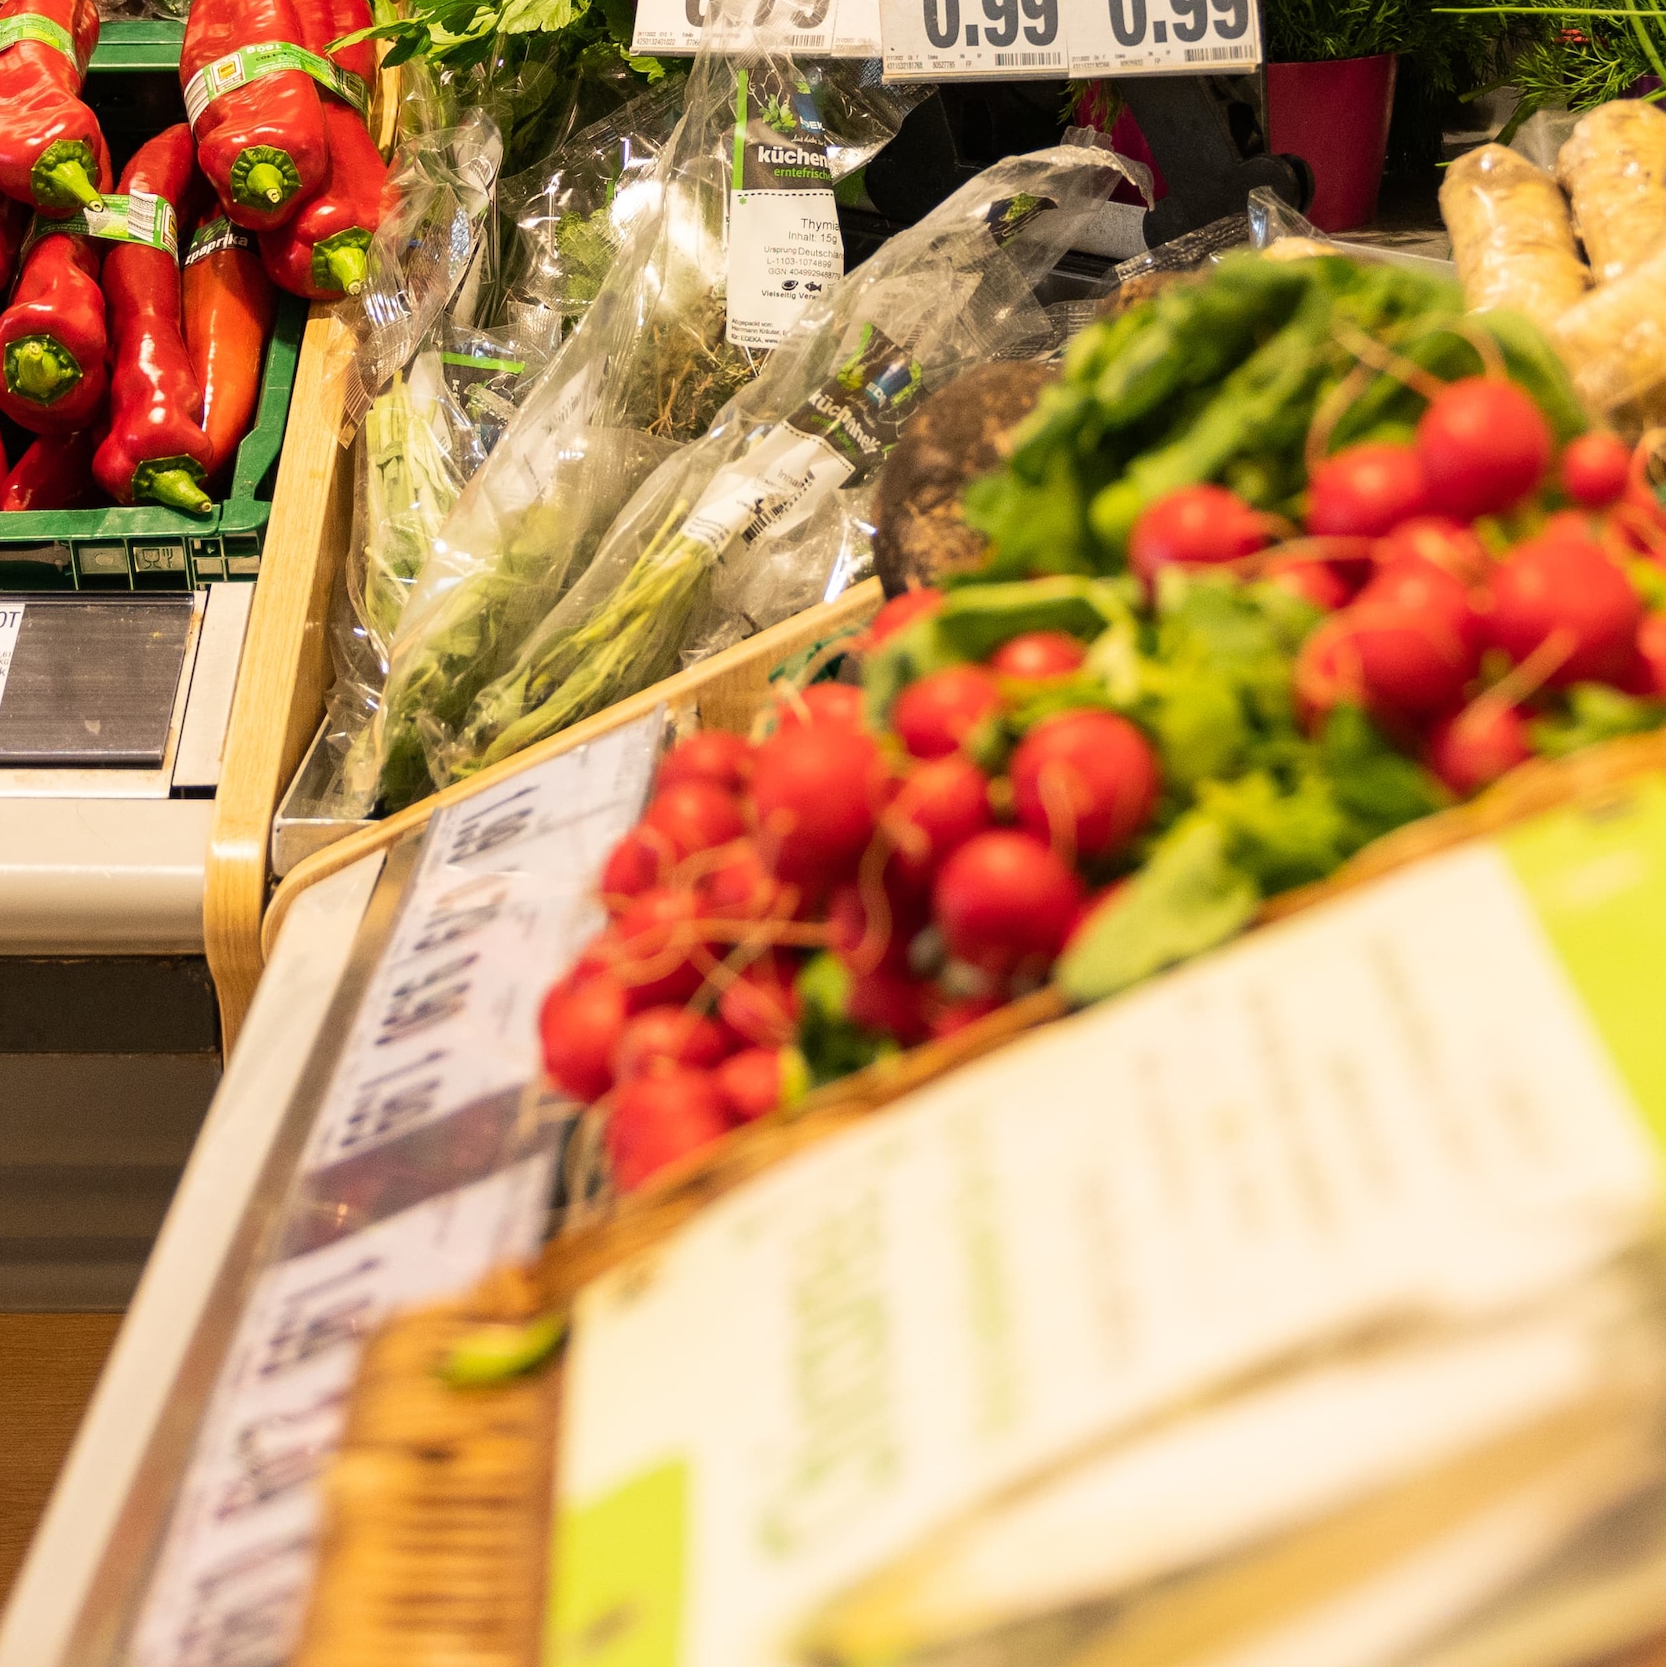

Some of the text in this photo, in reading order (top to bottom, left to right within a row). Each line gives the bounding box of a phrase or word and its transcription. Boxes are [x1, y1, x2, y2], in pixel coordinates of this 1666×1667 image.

[788, 231, 837, 244] Inhalt: 15g
[764, 246, 797, 255] Ursprung
[762, 290, 796, 299] Vielseitig
